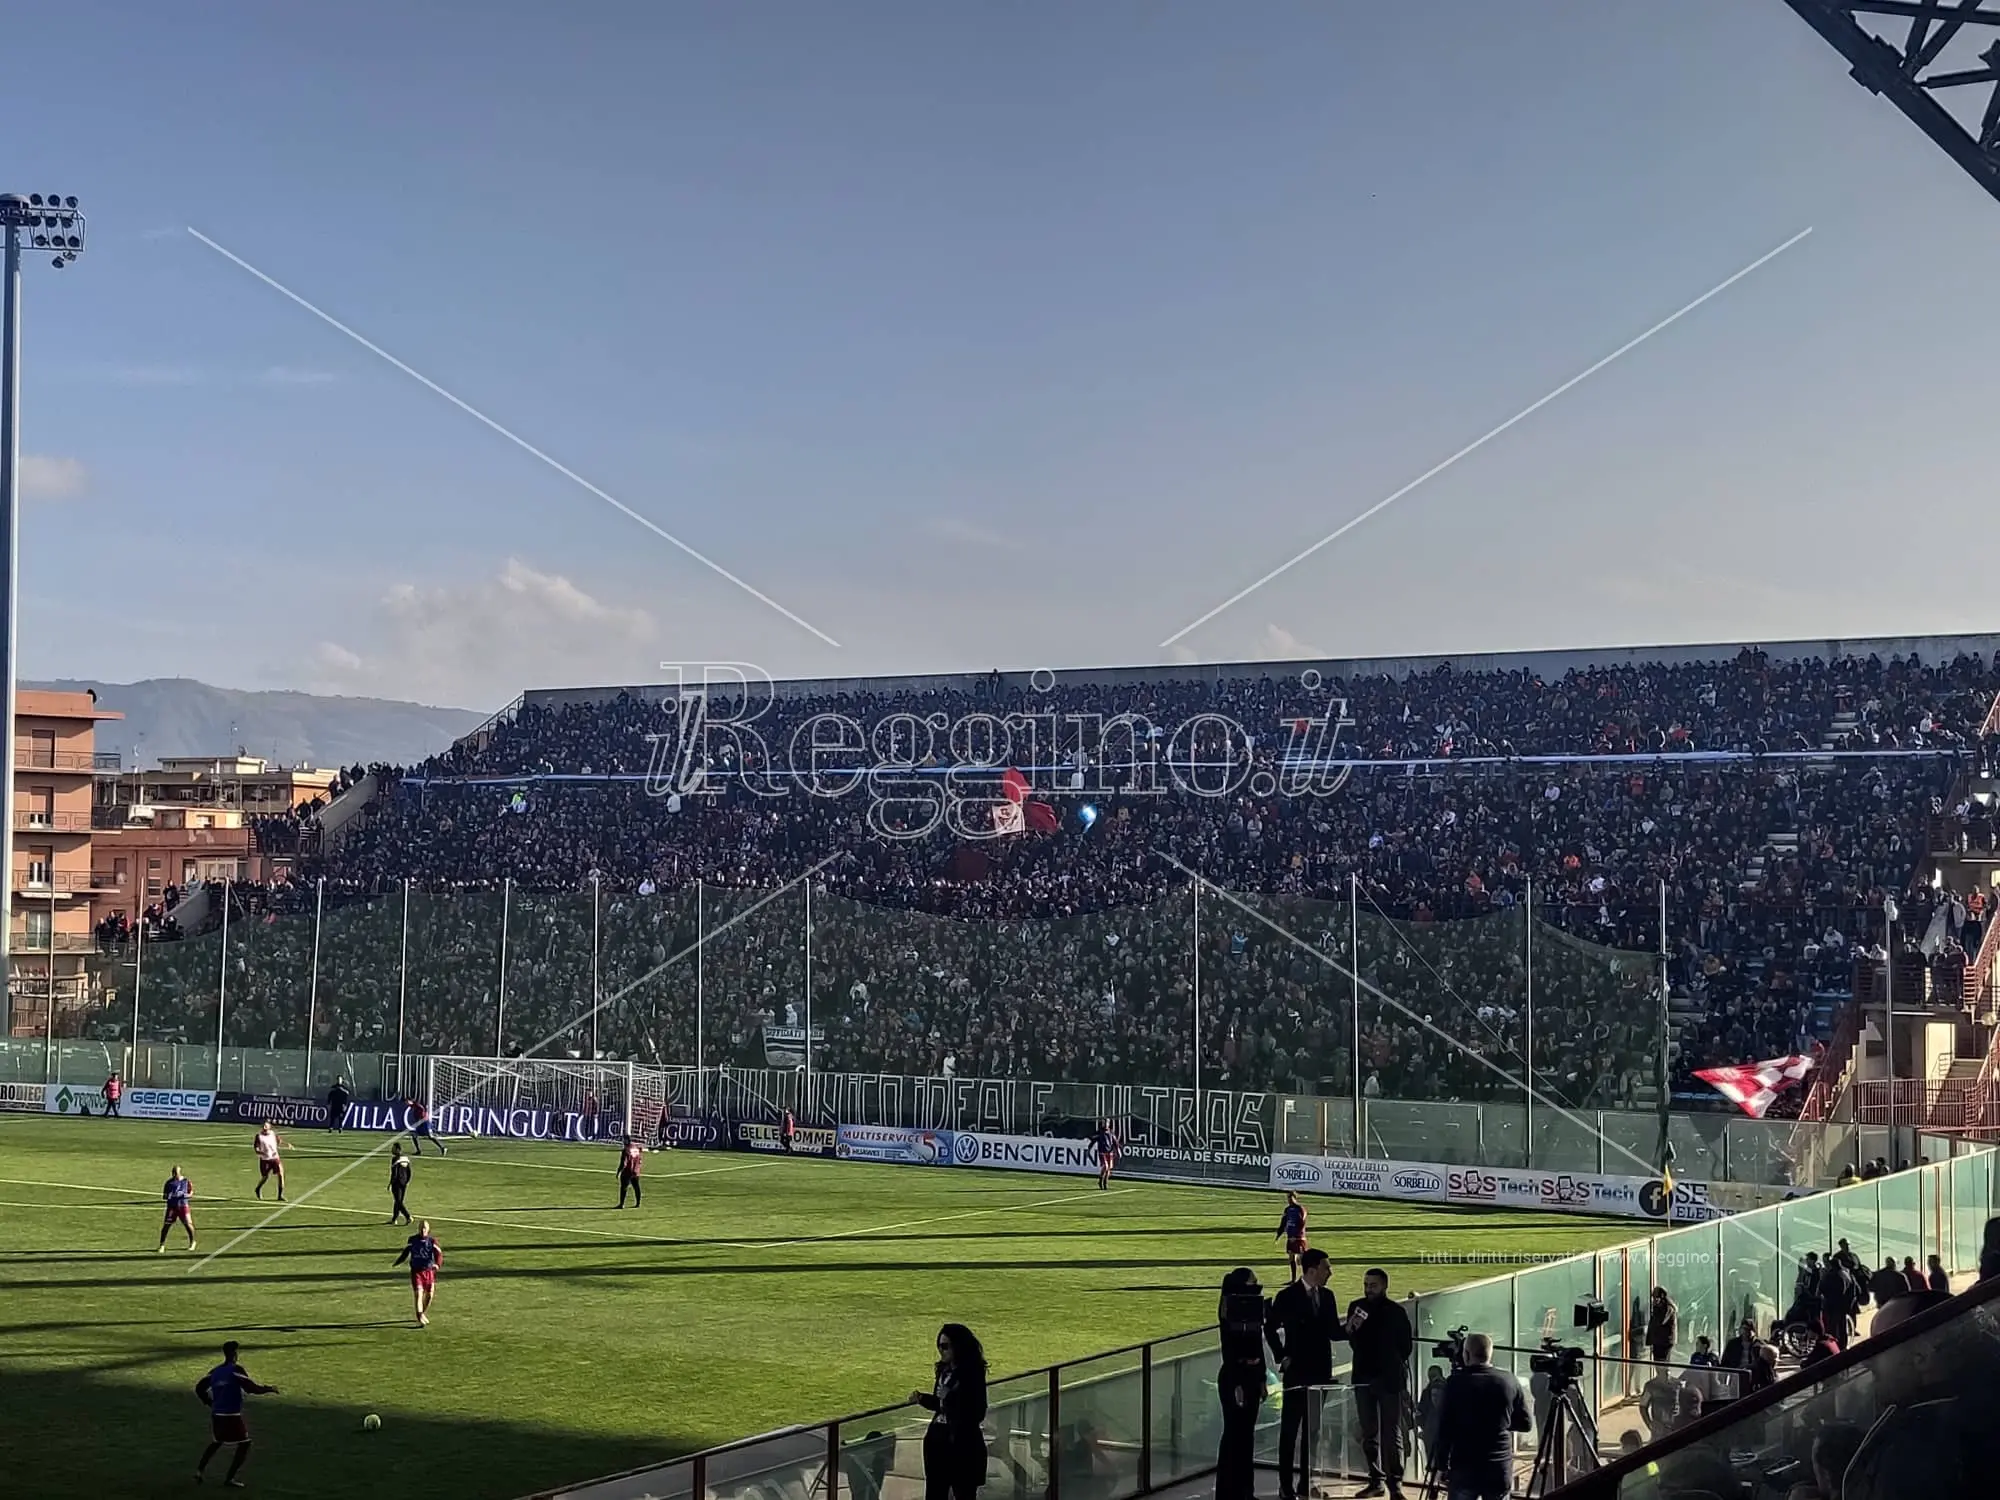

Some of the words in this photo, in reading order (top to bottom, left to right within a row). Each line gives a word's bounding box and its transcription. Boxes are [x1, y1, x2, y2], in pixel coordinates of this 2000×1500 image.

[238, 1102, 328, 1122] CHIRINGUITO
[1123, 1145, 1191, 1162] ORTOPEDIA
[1194, 1151, 1212, 1162] DE
[1214, 1153, 1271, 1167] STEFANO
[1276, 1168, 1320, 1182] SORBELLO
[1392, 1177, 1440, 1190] SORBELLO
